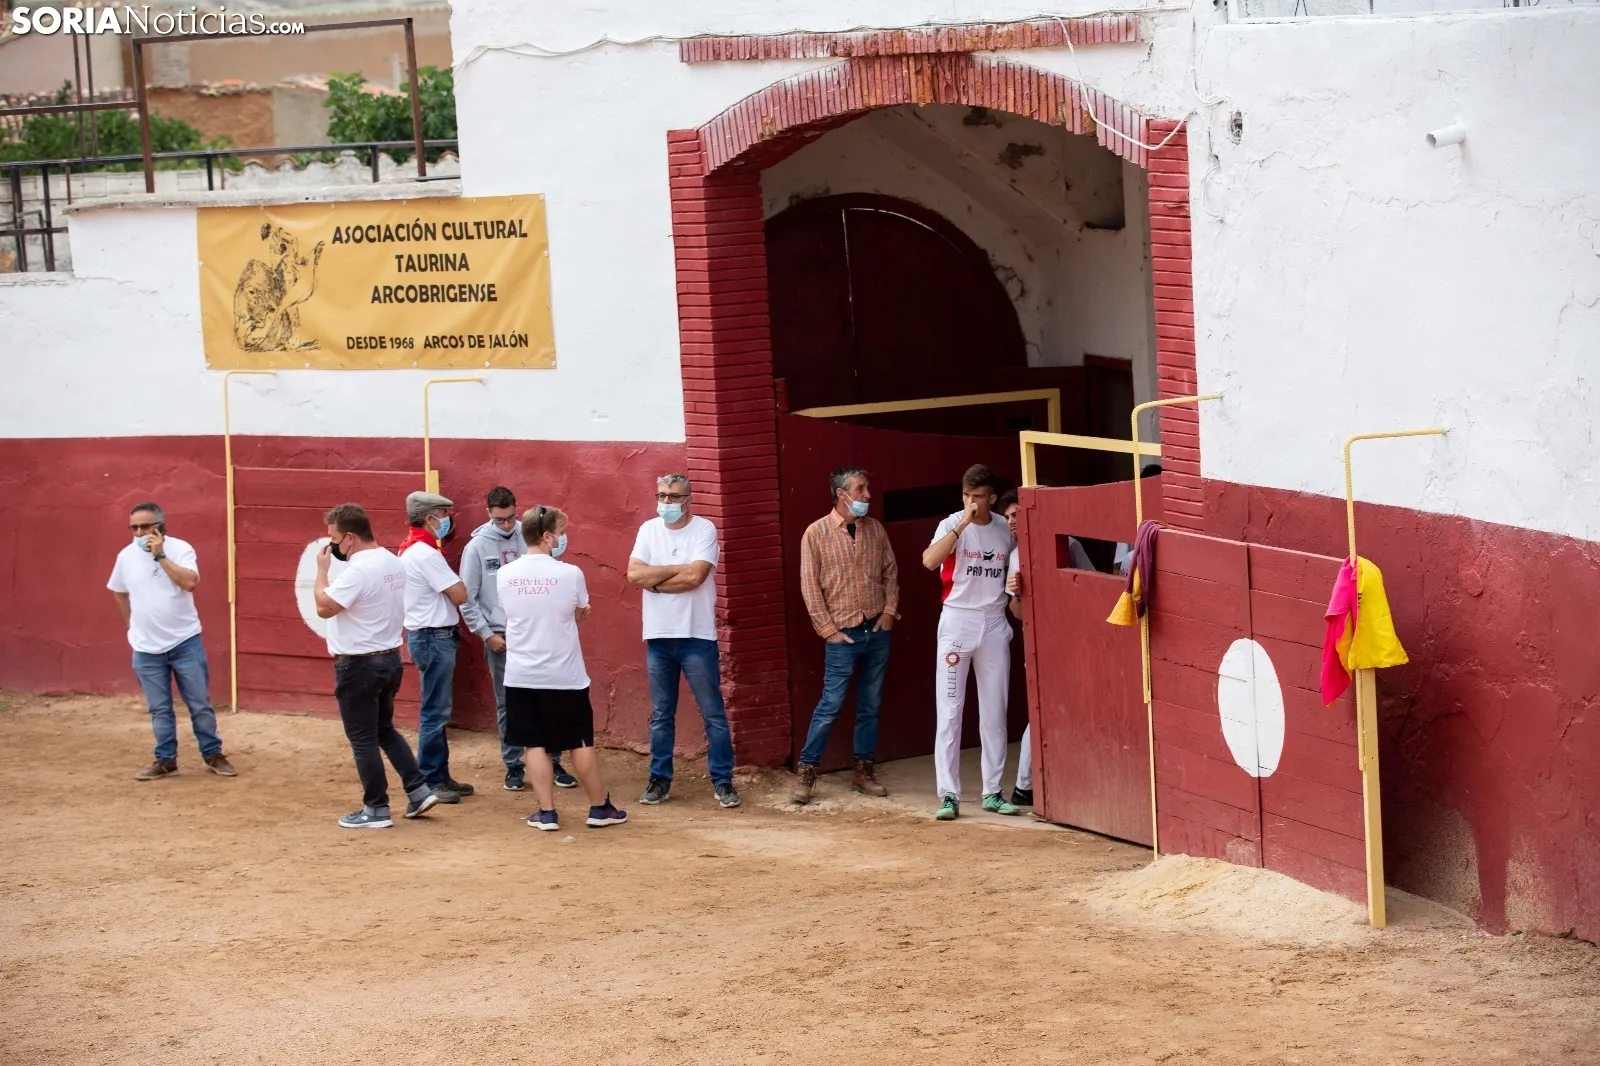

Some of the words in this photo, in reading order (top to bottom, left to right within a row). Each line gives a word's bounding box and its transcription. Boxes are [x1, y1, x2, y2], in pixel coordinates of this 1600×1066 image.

[331, 218, 437, 244] ASOCIACIÓN
[441, 219, 528, 240] CULTURAL
[395, 252, 470, 273] TAURINA
[371, 283, 498, 304] ARCOBRIGENSE
[346, 335, 387, 350] DESDE
[390, 337, 415, 350] 1968
[423, 335, 465, 349] ARCOS
[467, 335, 486, 348] DE
[488, 330, 529, 350] JALÓN
[966, 565, 983, 577] PRO
[508, 577, 558, 588] SERVICIO
[517, 586, 550, 596] PLAZA
